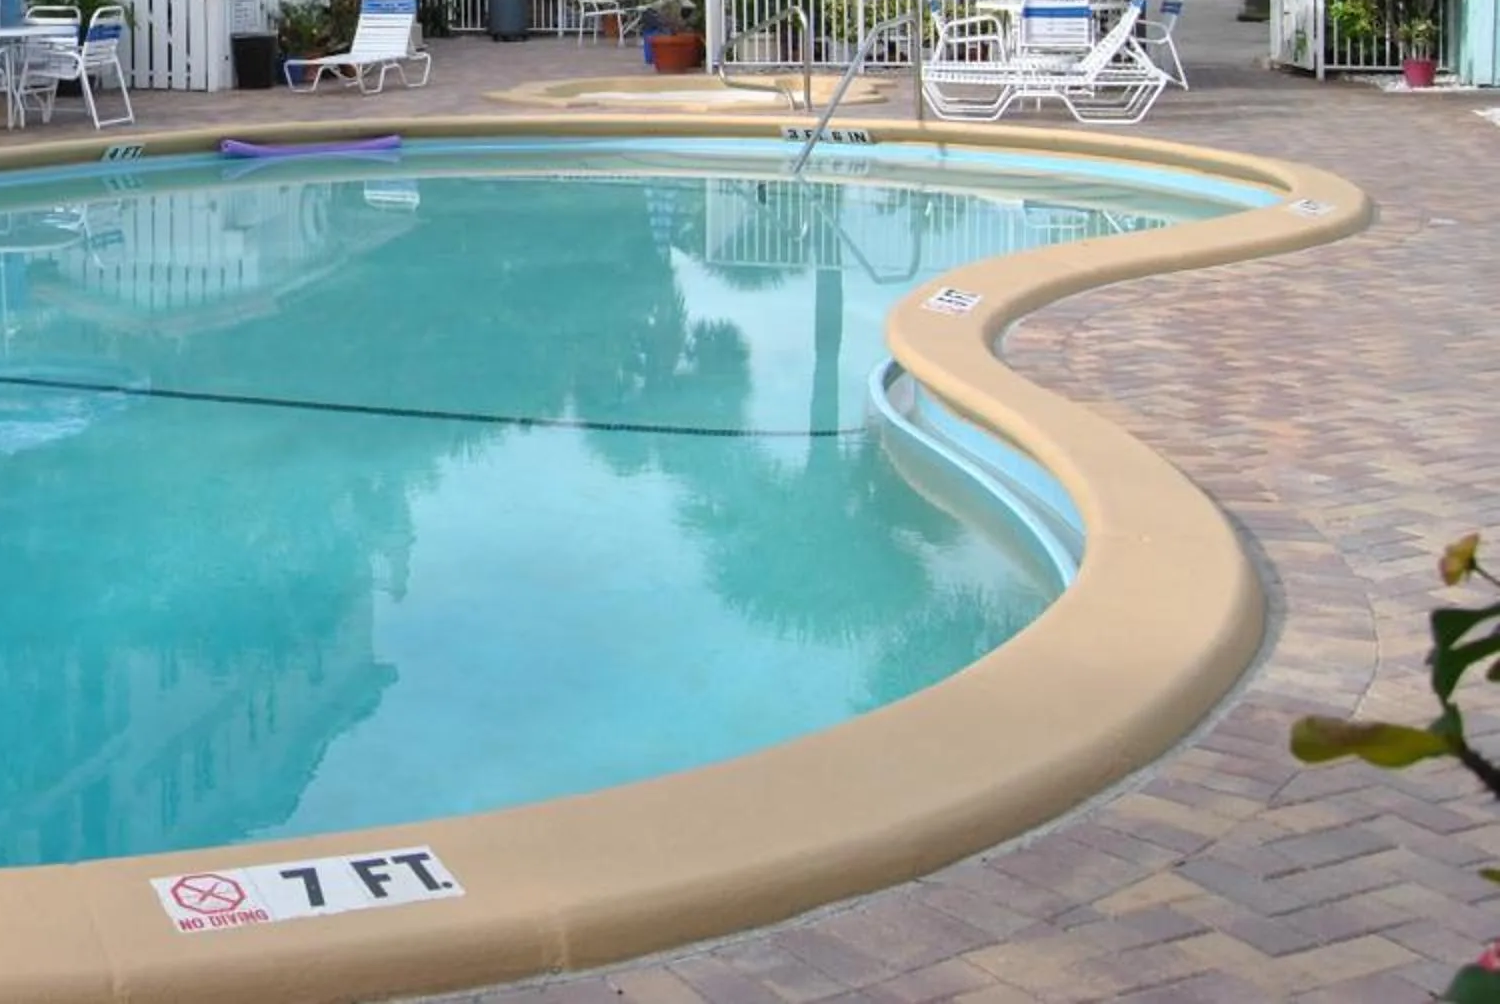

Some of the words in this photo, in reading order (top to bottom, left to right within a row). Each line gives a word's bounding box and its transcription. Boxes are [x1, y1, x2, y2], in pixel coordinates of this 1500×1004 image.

[108, 147, 120, 160] 4
[279, 867, 326, 908] 7
[350, 852, 454, 899] FT.
[179, 917, 205, 931] NO
[208, 908, 269, 928] DIVING
